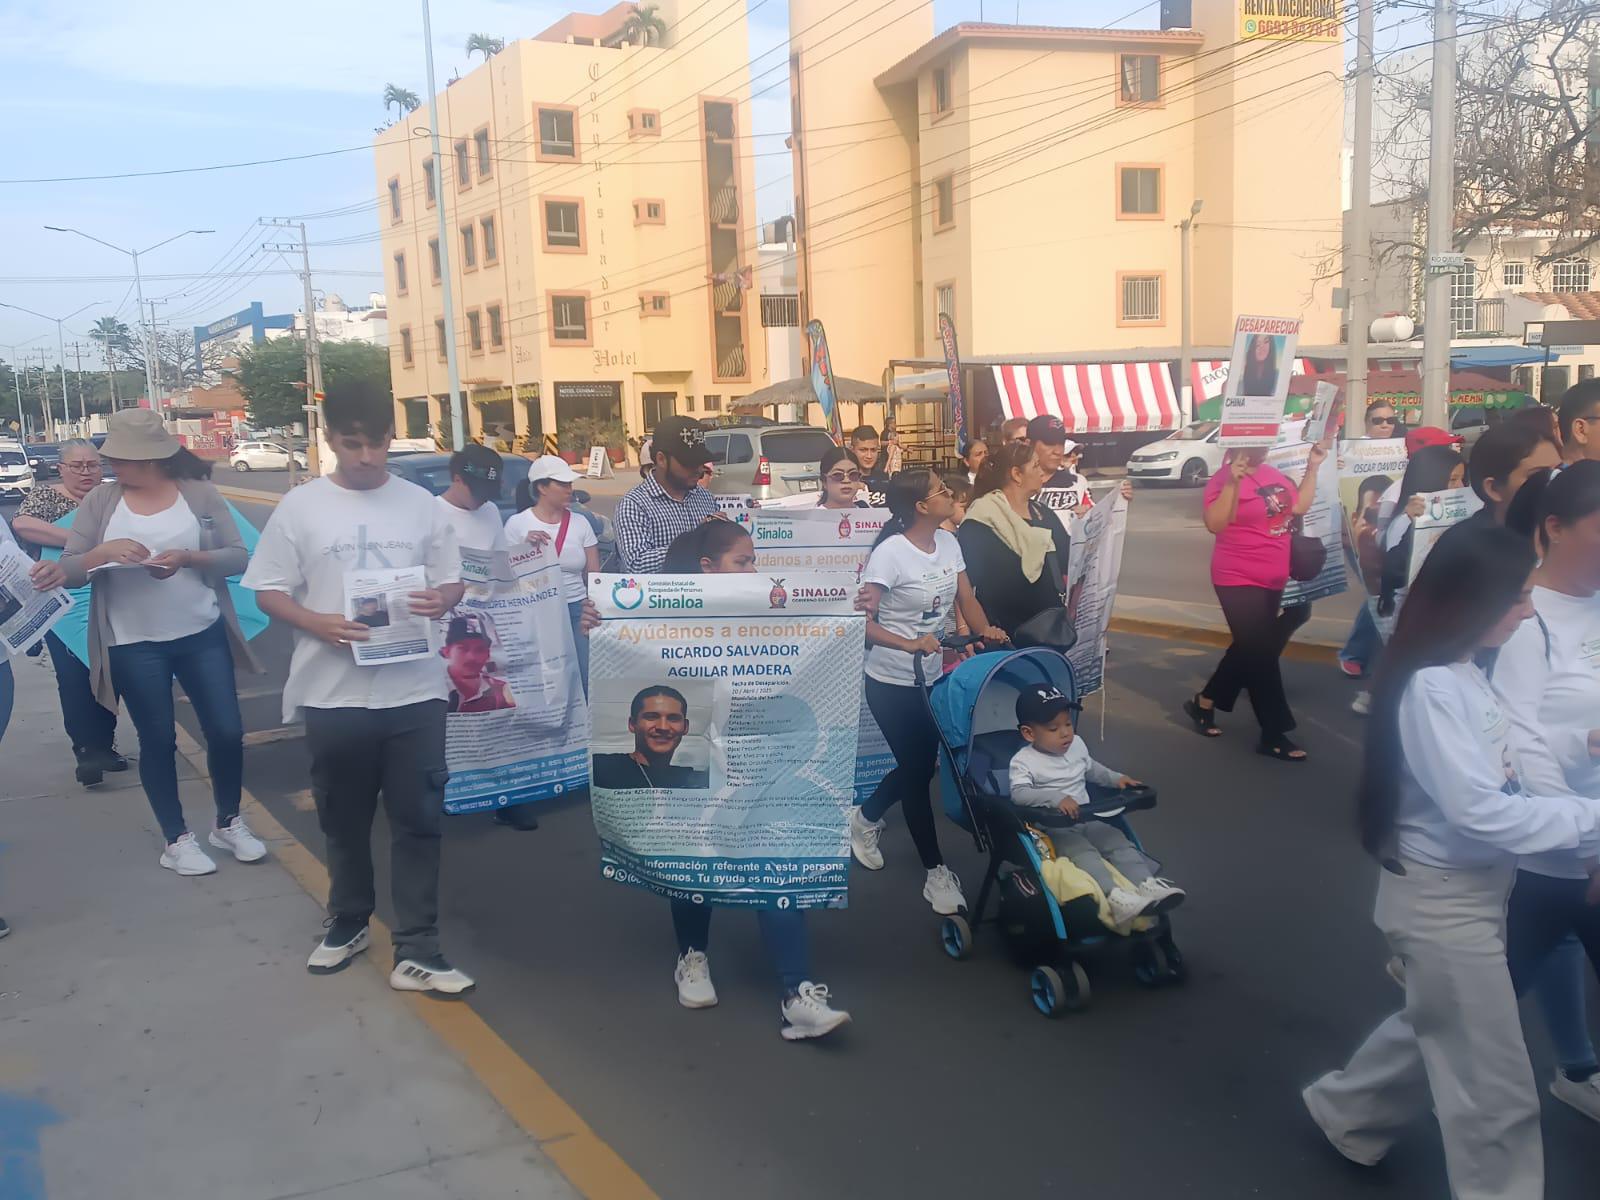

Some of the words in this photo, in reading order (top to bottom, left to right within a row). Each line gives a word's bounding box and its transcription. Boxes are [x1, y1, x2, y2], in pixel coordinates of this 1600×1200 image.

[1244, 0, 1275, 15] RENTA
[1277, 0, 1338, 19] VACACIONAL
[1239, 318, 1301, 335] DESAPARECIDA
[593, 350, 638, 374] Hotel
[1202, 367, 1230, 385] TACO
[1225, 397, 1246, 408] CHINA
[1353, 462, 1377, 474] OSCAR
[855, 521, 884, 529] SINAL
[757, 527, 793, 540] Sinaloa
[792, 587, 847, 597] SINALOA
[648, 594, 703, 609] Sinaloa
[619, 622, 715, 644] Ayúdanos
[721, 627, 732, 638] a
[737, 624, 830, 638] encontrar
[835, 625, 846, 637] a
[661, 645, 723, 659] RICARDO
[726, 644, 800, 658] SALVADOR
[667, 664, 728, 678] AGUILAR
[732, 663, 792, 677] MADERA
[713, 862, 760, 871] referente
[776, 862, 798, 871] esta
[802, 863, 847, 873] persona.
[697, 873, 710, 883] Tu
[713, 874, 745, 885] ayuda
[763, 875, 788, 886] muy
